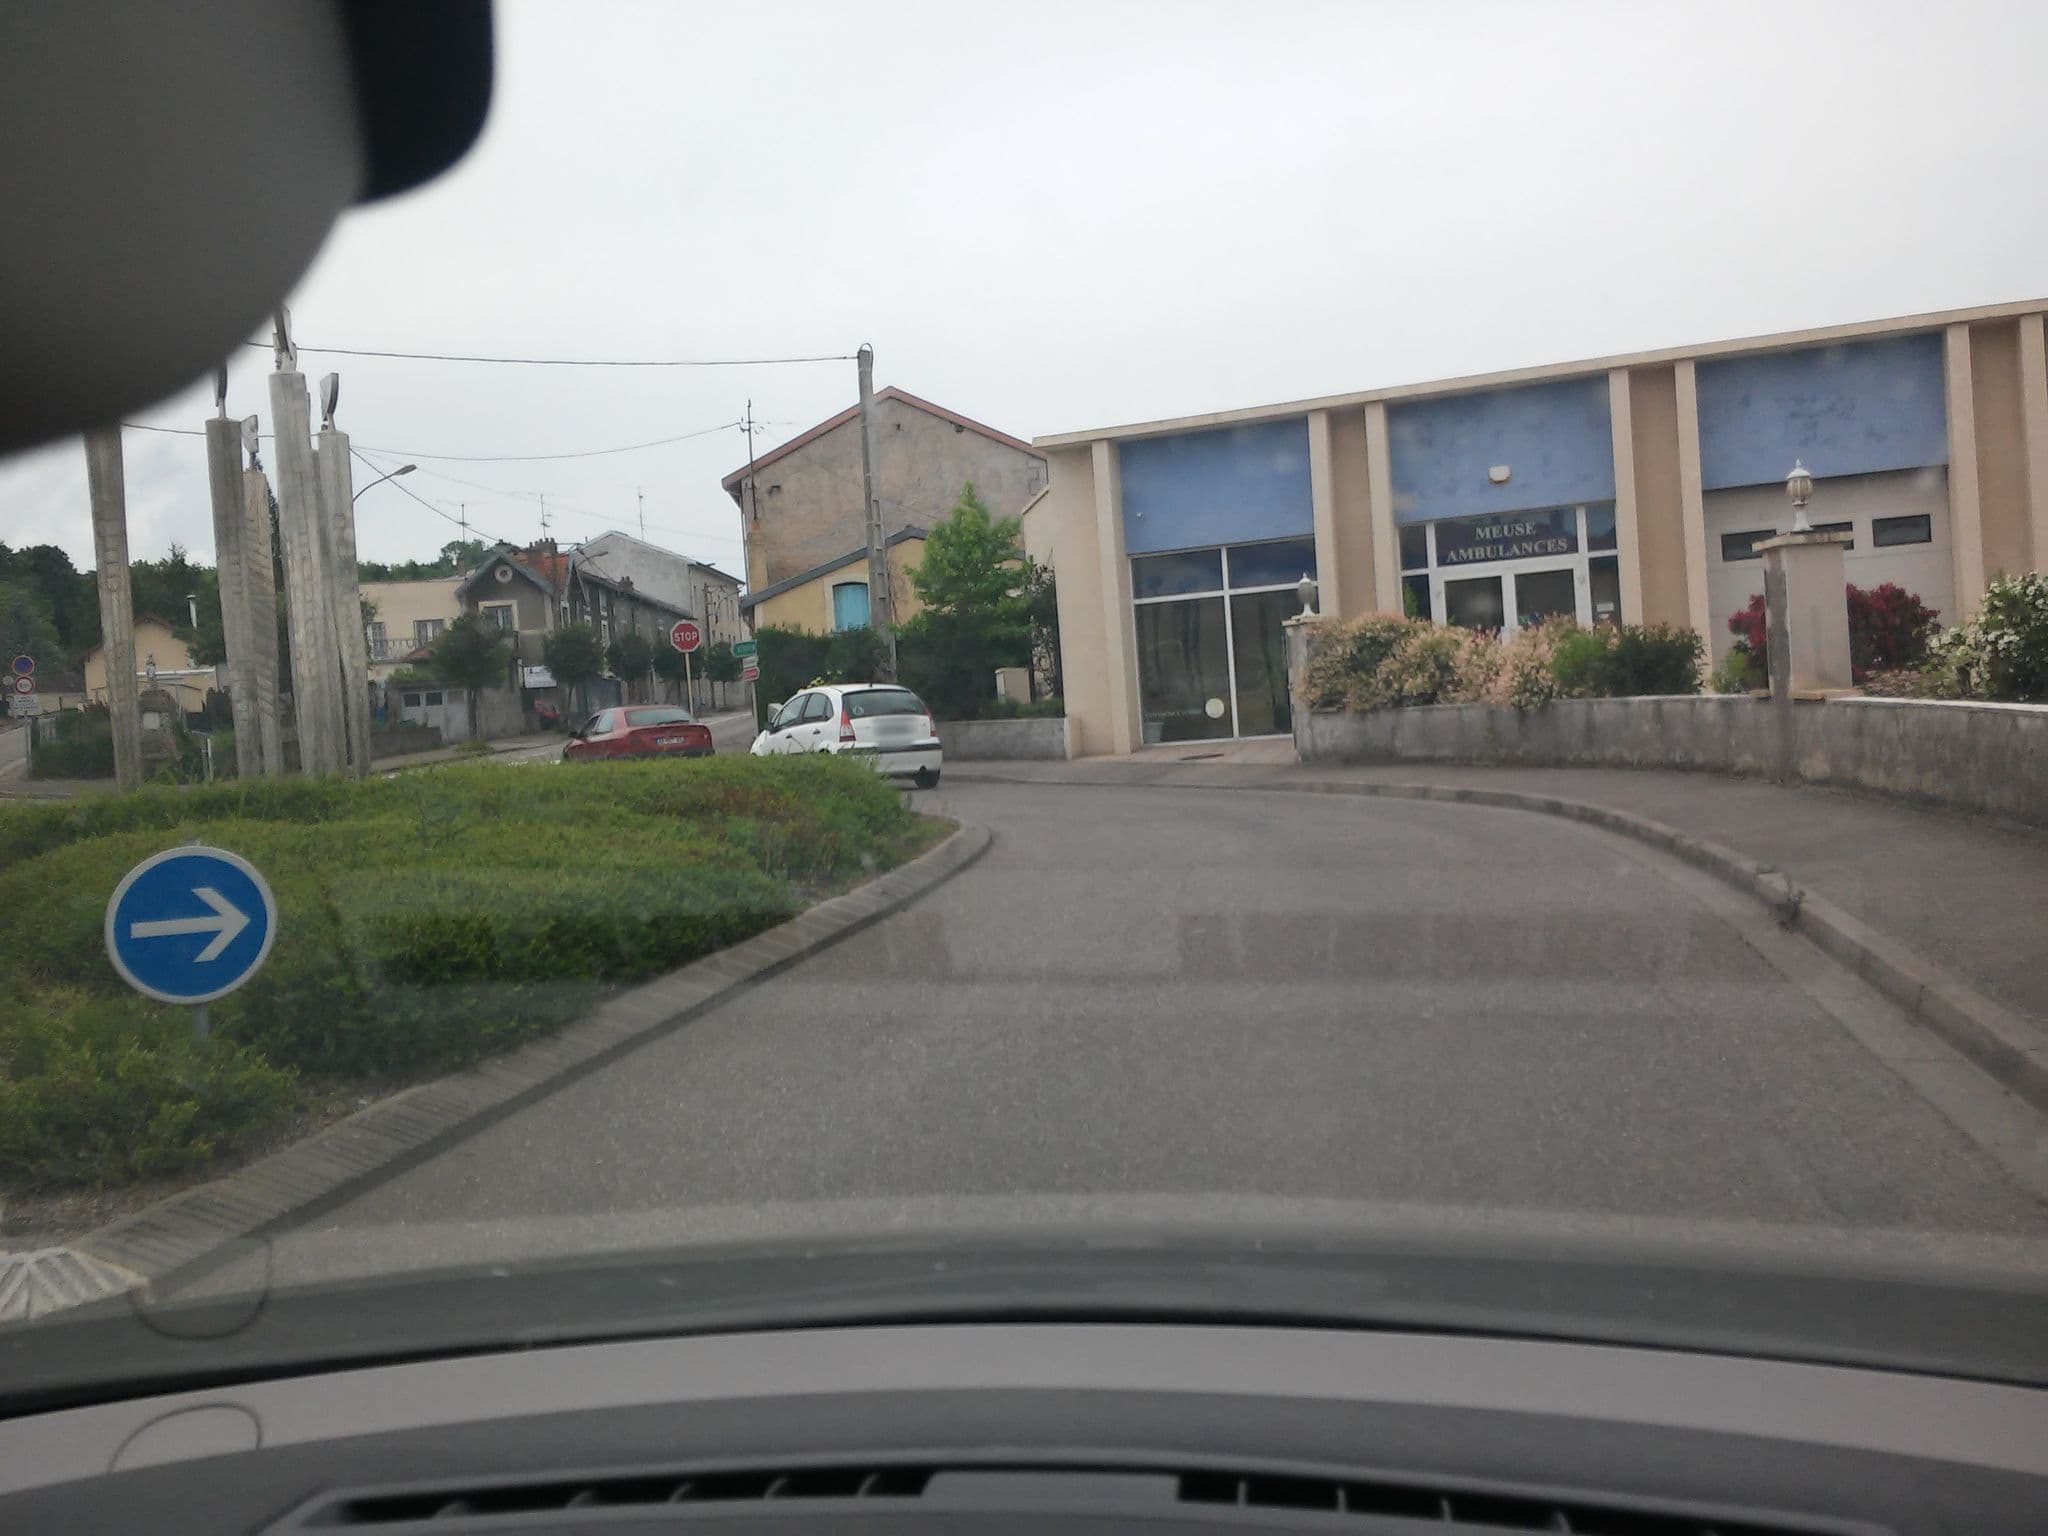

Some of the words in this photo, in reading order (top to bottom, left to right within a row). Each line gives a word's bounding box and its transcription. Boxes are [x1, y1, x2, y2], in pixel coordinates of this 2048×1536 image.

[1475, 520, 1537, 540] MEUSE
[1447, 537, 1568, 563] AMBULANCES
[674, 631, 698, 642] STOP
